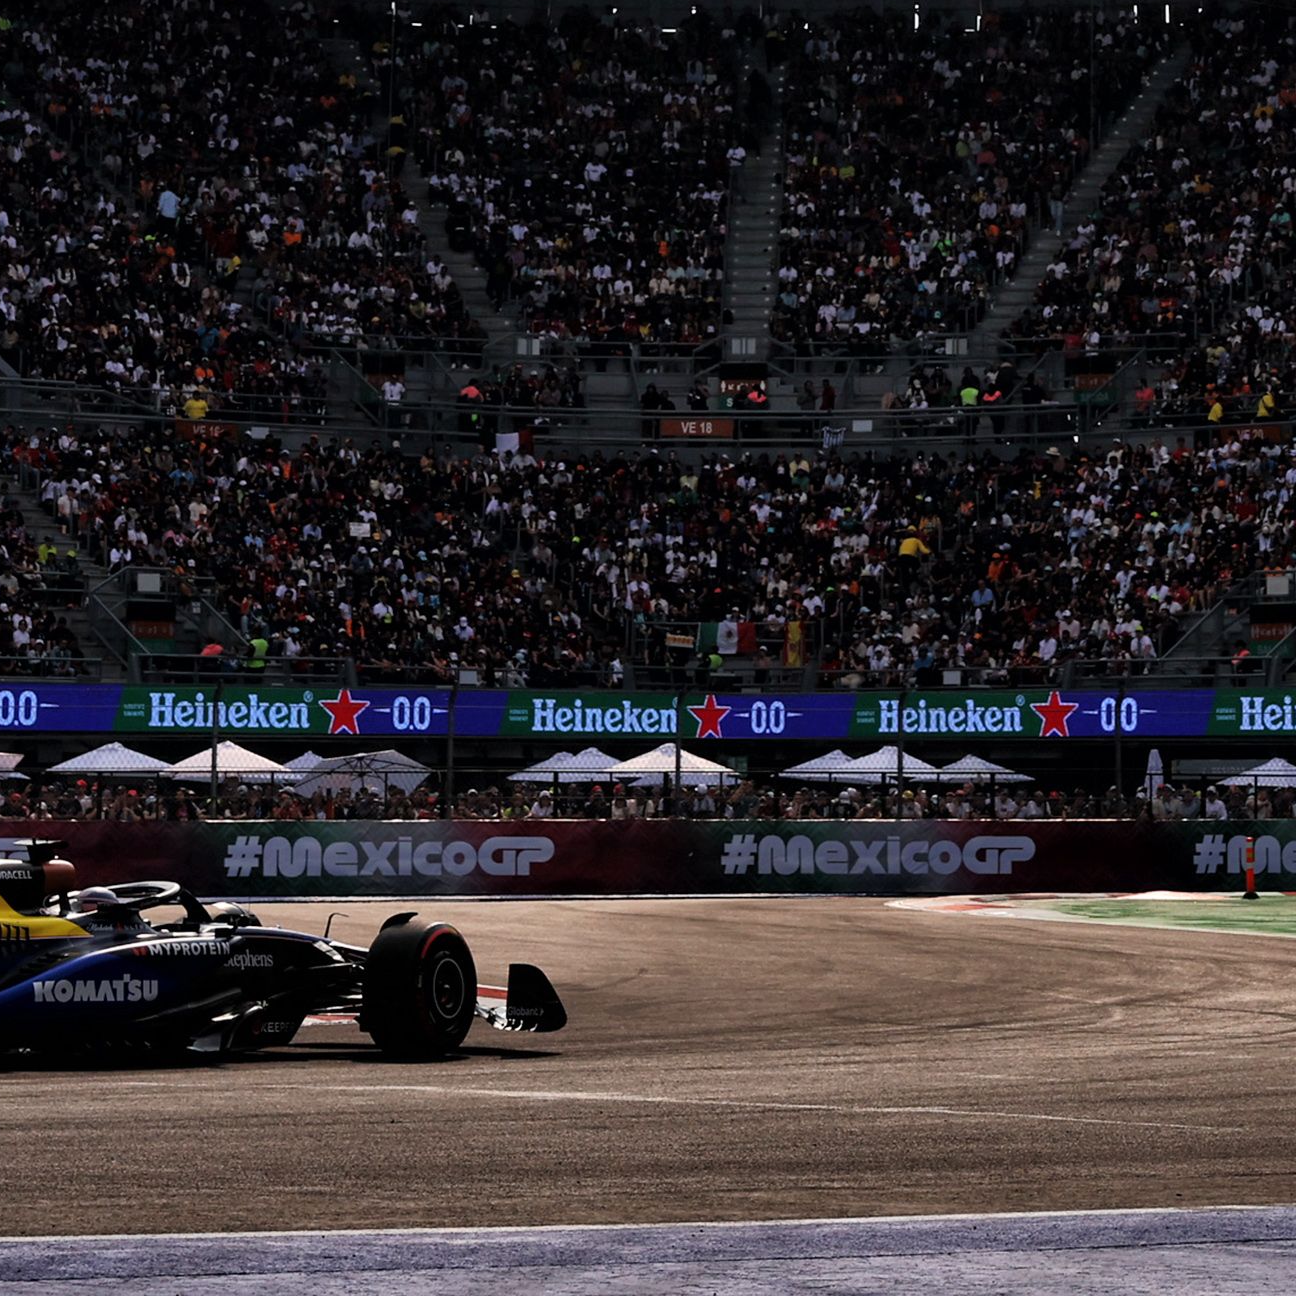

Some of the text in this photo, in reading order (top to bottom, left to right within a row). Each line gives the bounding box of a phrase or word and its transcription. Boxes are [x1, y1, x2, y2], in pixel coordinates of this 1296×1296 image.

[681, 421, 712, 434] VE 18
[393, 696, 430, 730] 0.0
[751, 701, 785, 734] 0.0
[224, 836, 555, 877] #MexicoGP
[721, 834, 1036, 876] #MexicoGP
[147, 942, 231, 956] MYPROTEIN
[32, 973, 159, 1003] KOMATSU
